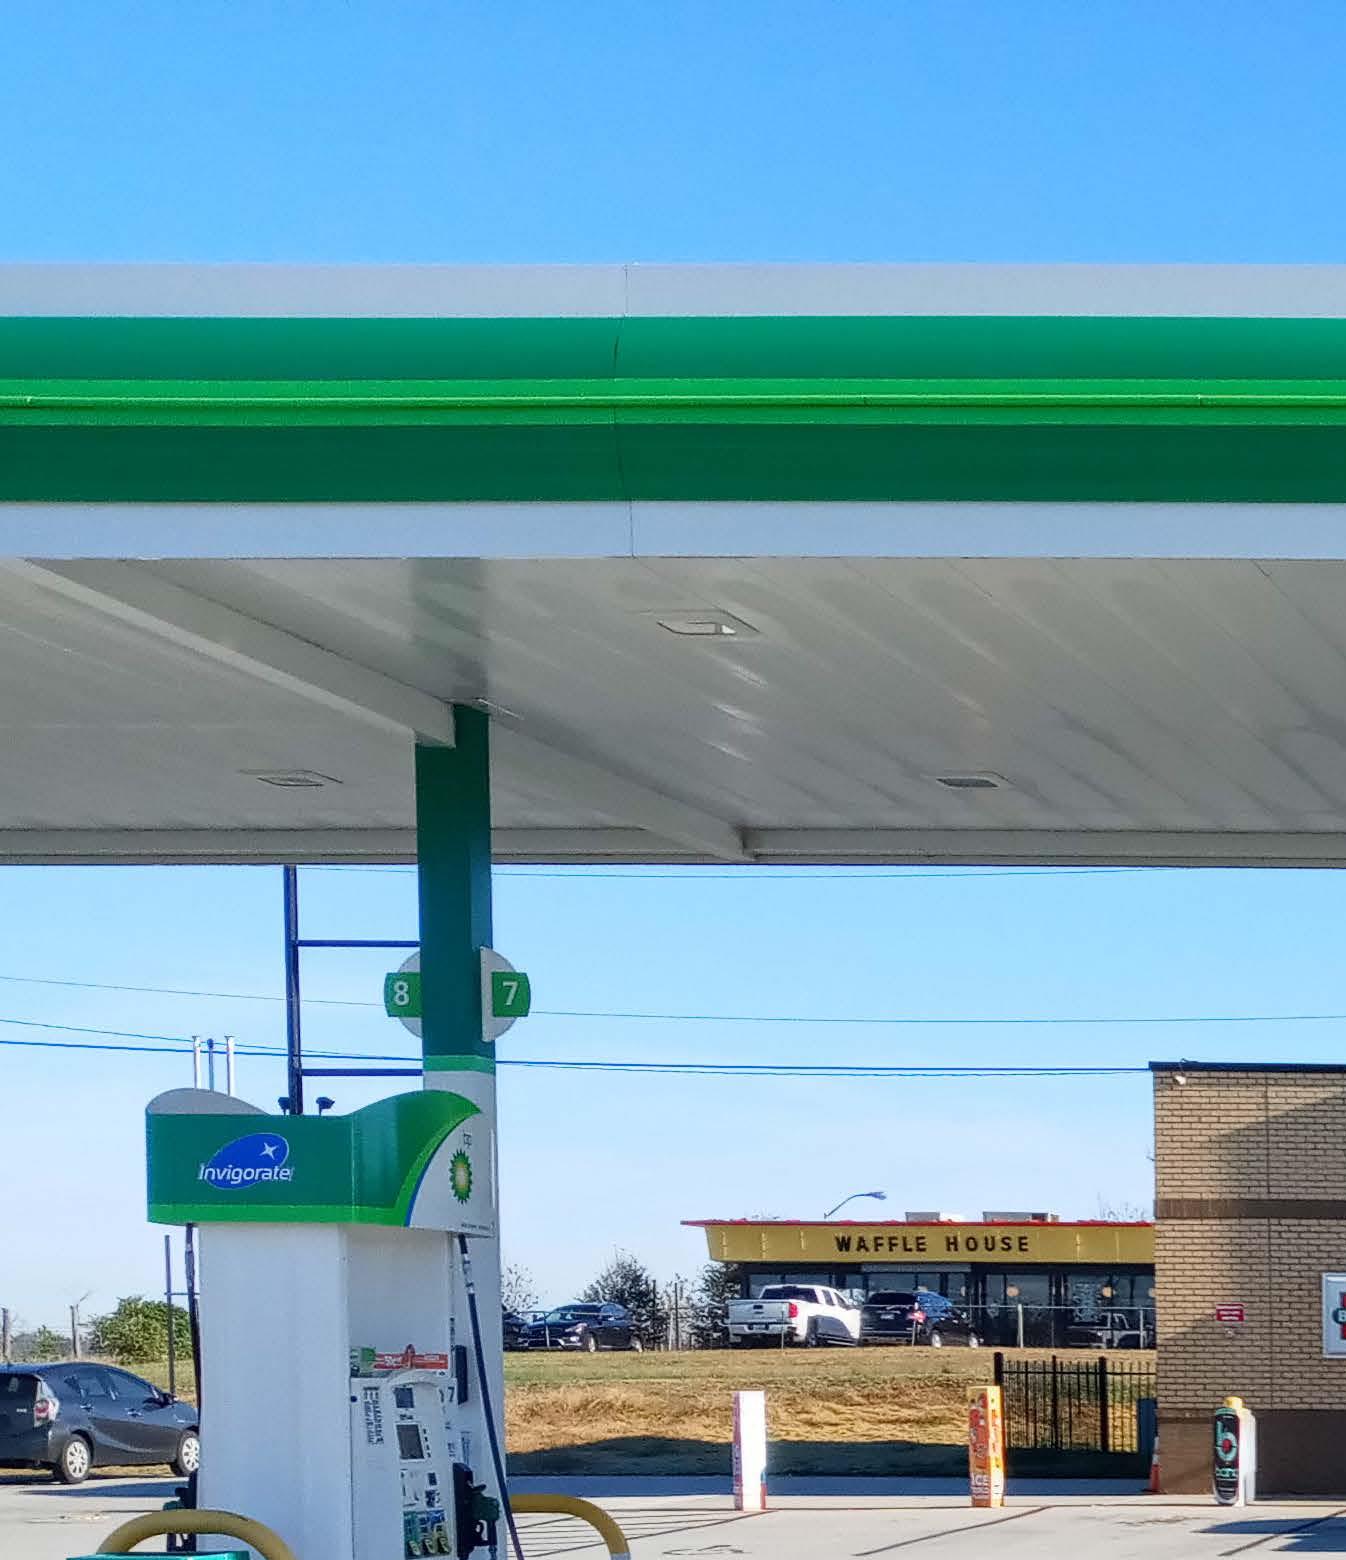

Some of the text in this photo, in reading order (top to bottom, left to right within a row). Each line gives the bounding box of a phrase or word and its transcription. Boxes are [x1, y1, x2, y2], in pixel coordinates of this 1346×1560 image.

[393, 980, 410, 1006] 8
[502, 981, 519, 1006] 7
[198, 1163, 292, 1185] Invigorate
[835, 1235, 1030, 1252] WAFFLE HOUSE
